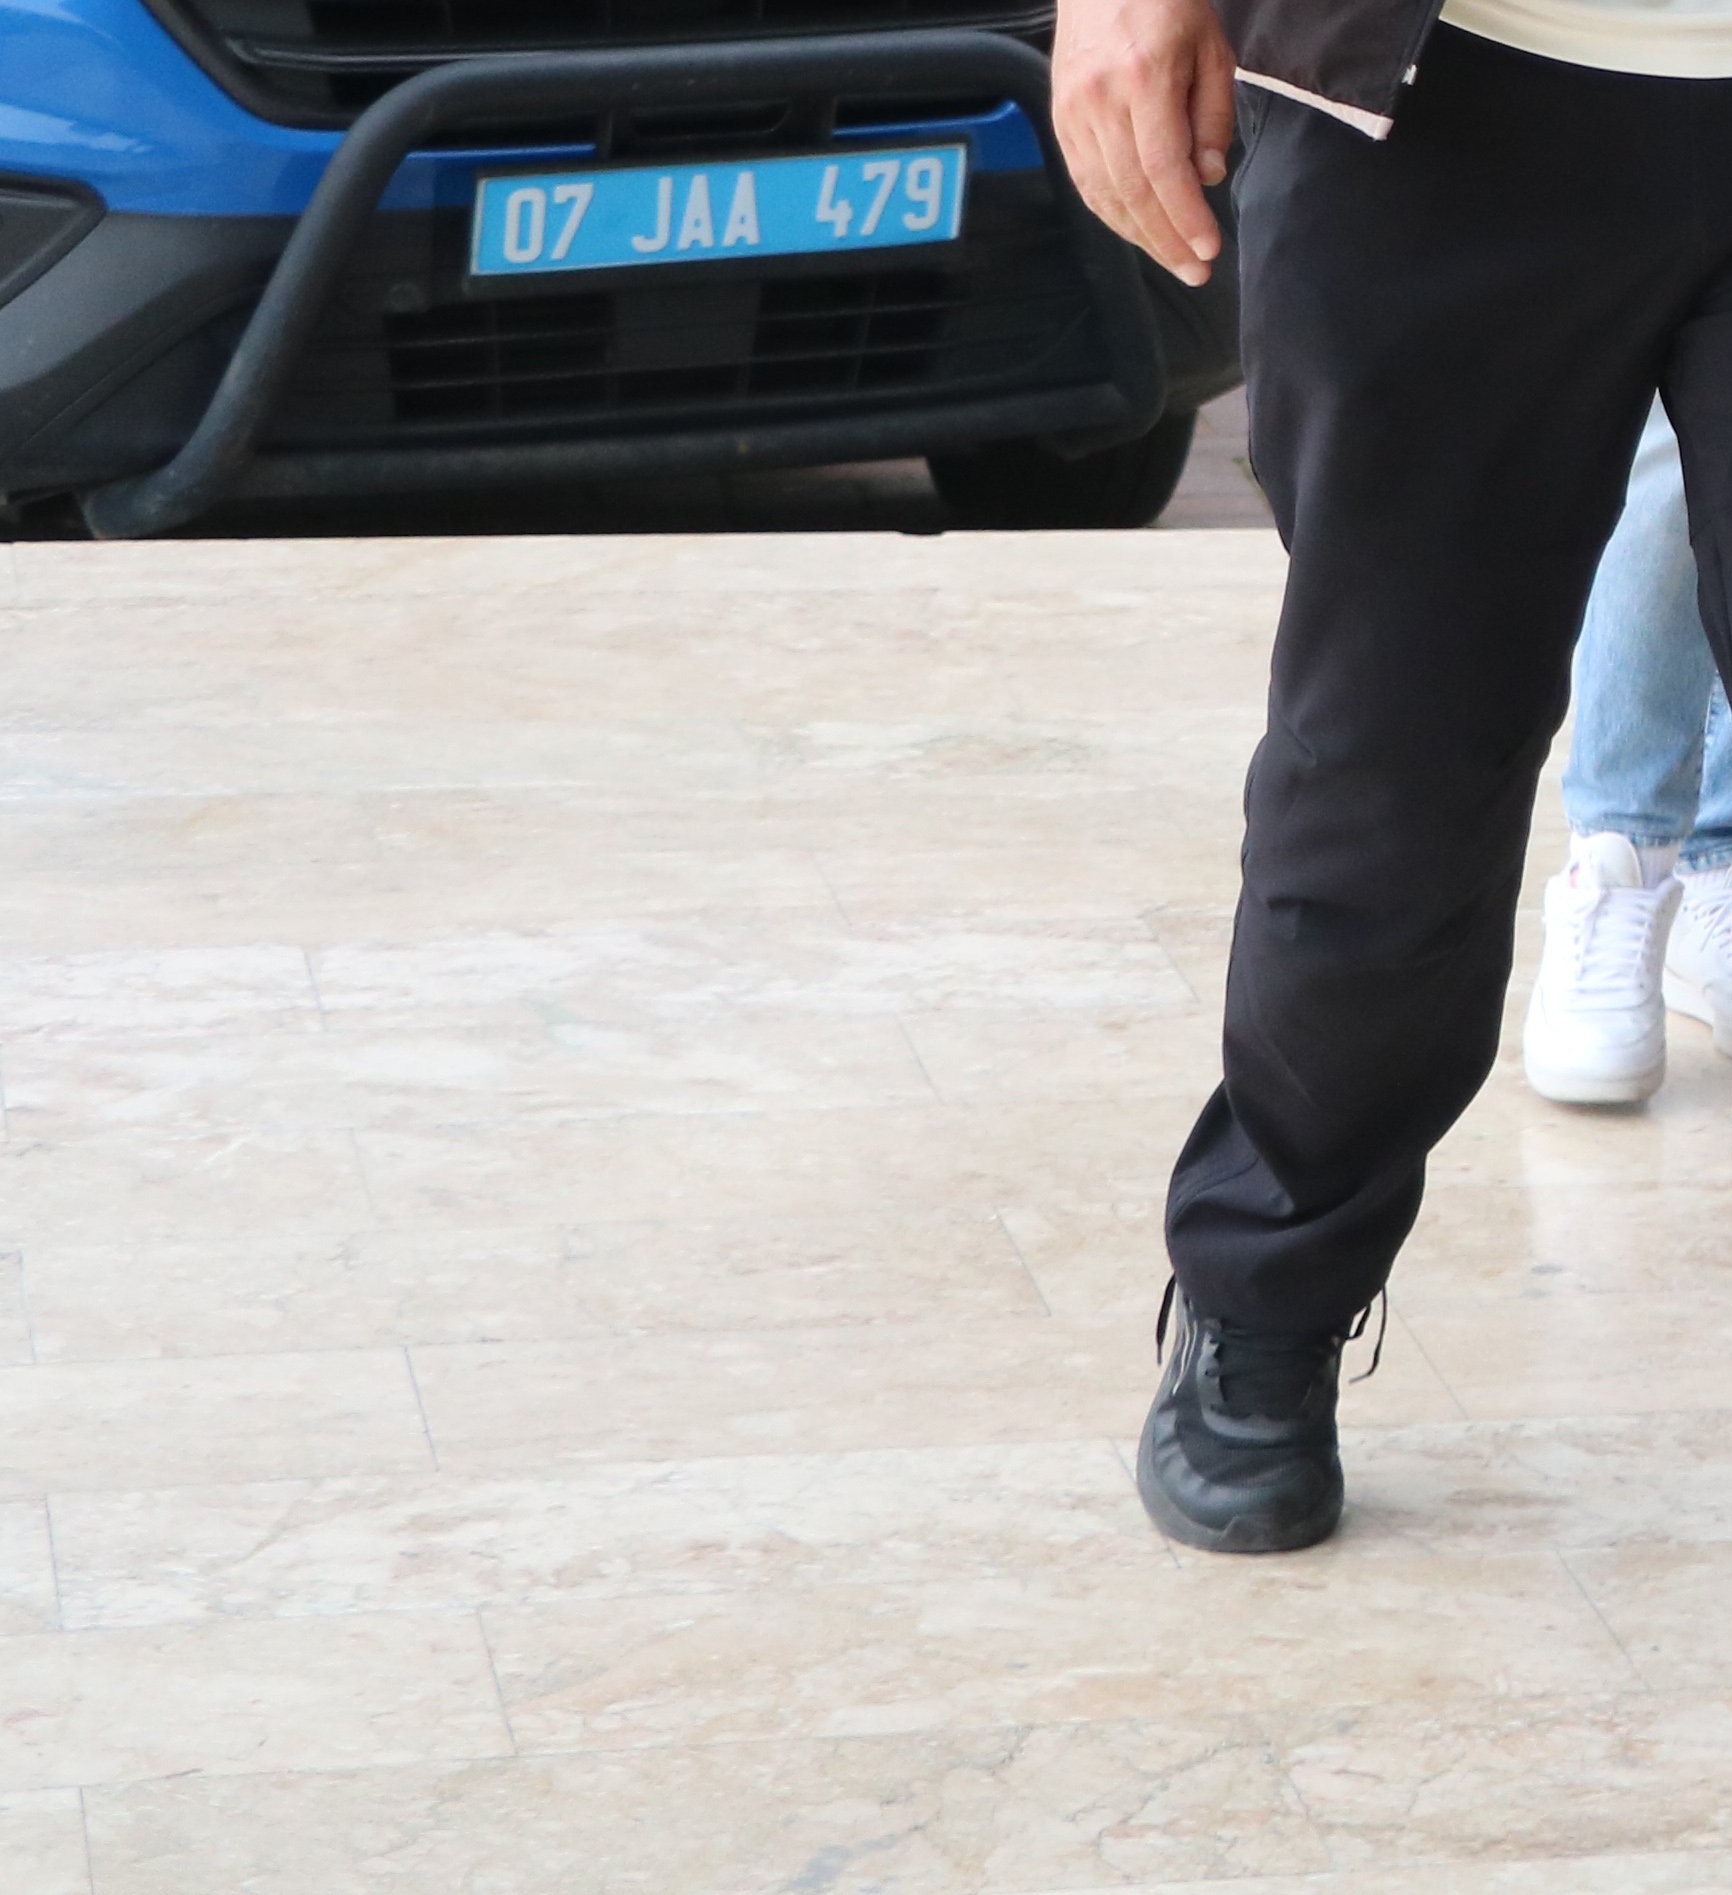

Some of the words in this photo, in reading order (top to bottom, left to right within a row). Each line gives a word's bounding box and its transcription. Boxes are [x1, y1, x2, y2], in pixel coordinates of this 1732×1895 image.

[503, 183, 594, 264] 07
[631, 170, 761, 253] JAA
[814, 156, 944, 239] 479
